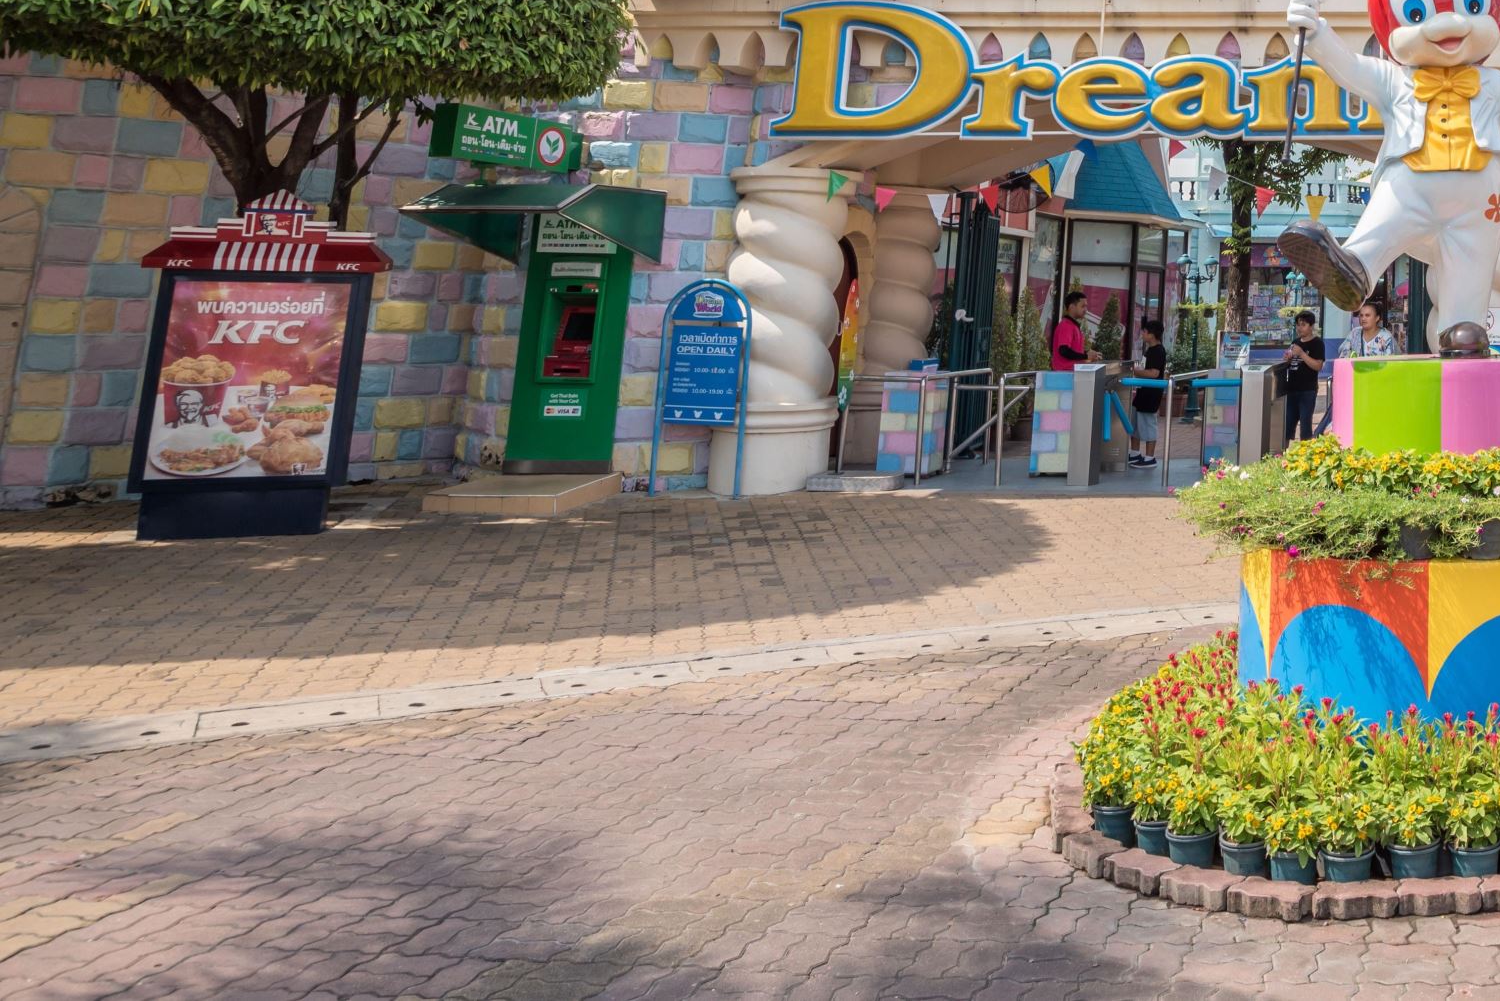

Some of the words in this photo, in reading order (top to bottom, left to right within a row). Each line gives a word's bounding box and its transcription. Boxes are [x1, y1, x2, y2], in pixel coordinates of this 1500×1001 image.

[482, 115, 518, 137] ATM
[166, 259, 193, 267] KFC
[336, 263, 360, 271] KFC
[197, 291, 325, 314] พบความอร่อยที่
[208, 320, 306, 344] KFC
[680, 333, 738, 344] เวลาเปิดทำการ
[677, 346, 704, 354] OPEN
[707, 347, 737, 355] DAILY
